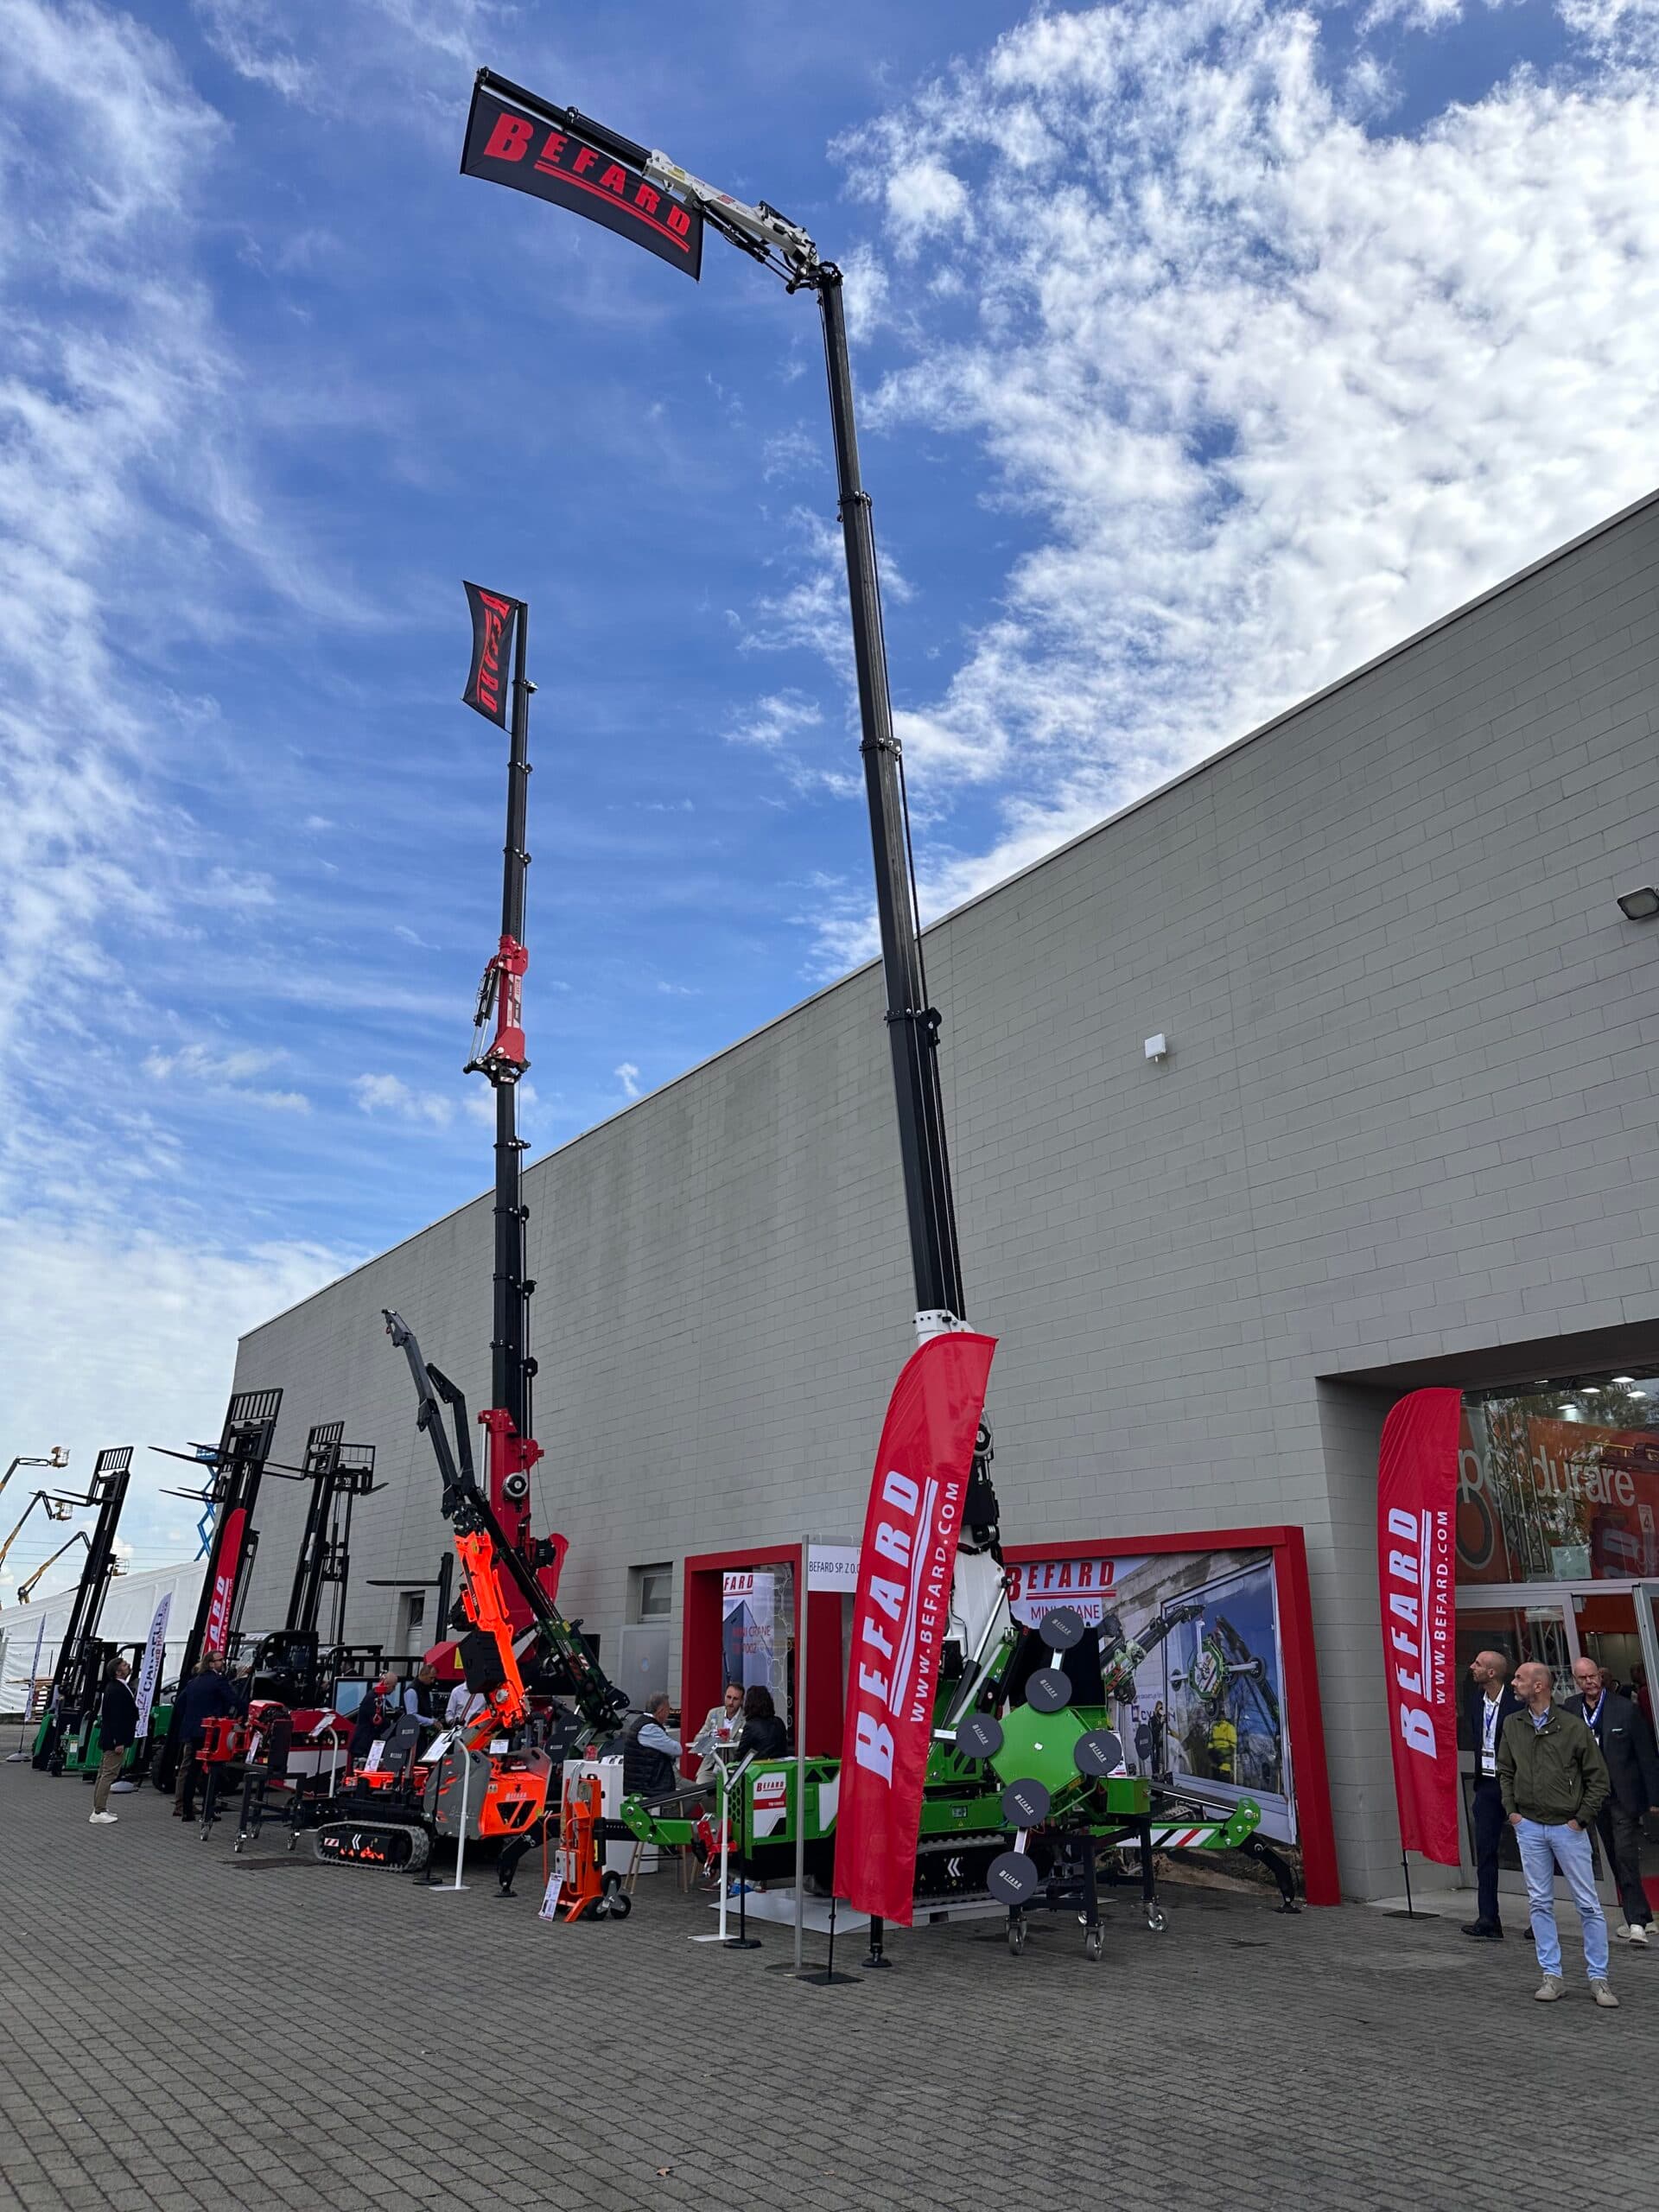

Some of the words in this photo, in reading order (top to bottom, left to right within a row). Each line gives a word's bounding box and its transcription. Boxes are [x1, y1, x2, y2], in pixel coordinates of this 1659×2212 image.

[482, 112, 690, 237] BEFARD
[724, 1574, 753, 1591] FARD
[809, 1561, 834, 1573] BEFARD
[1005, 1560, 1115, 1602] BEFARD
[910, 1481, 959, 1722] WWW.BEFARD.COM
[1031, 1605, 1056, 1620] MIN
[1062, 1605, 1100, 1619] ANE
[1434, 1510, 1448, 1705] WWW.BEFARD.COM
[855, 1470, 919, 1789] BEFARD
[1389, 1508, 1438, 1759] BEFARD
[757, 1782, 785, 1792] BEFARD
[1014, 1794, 1034, 1815] BEFARD
[999, 1870, 1023, 1889] BEFARD
